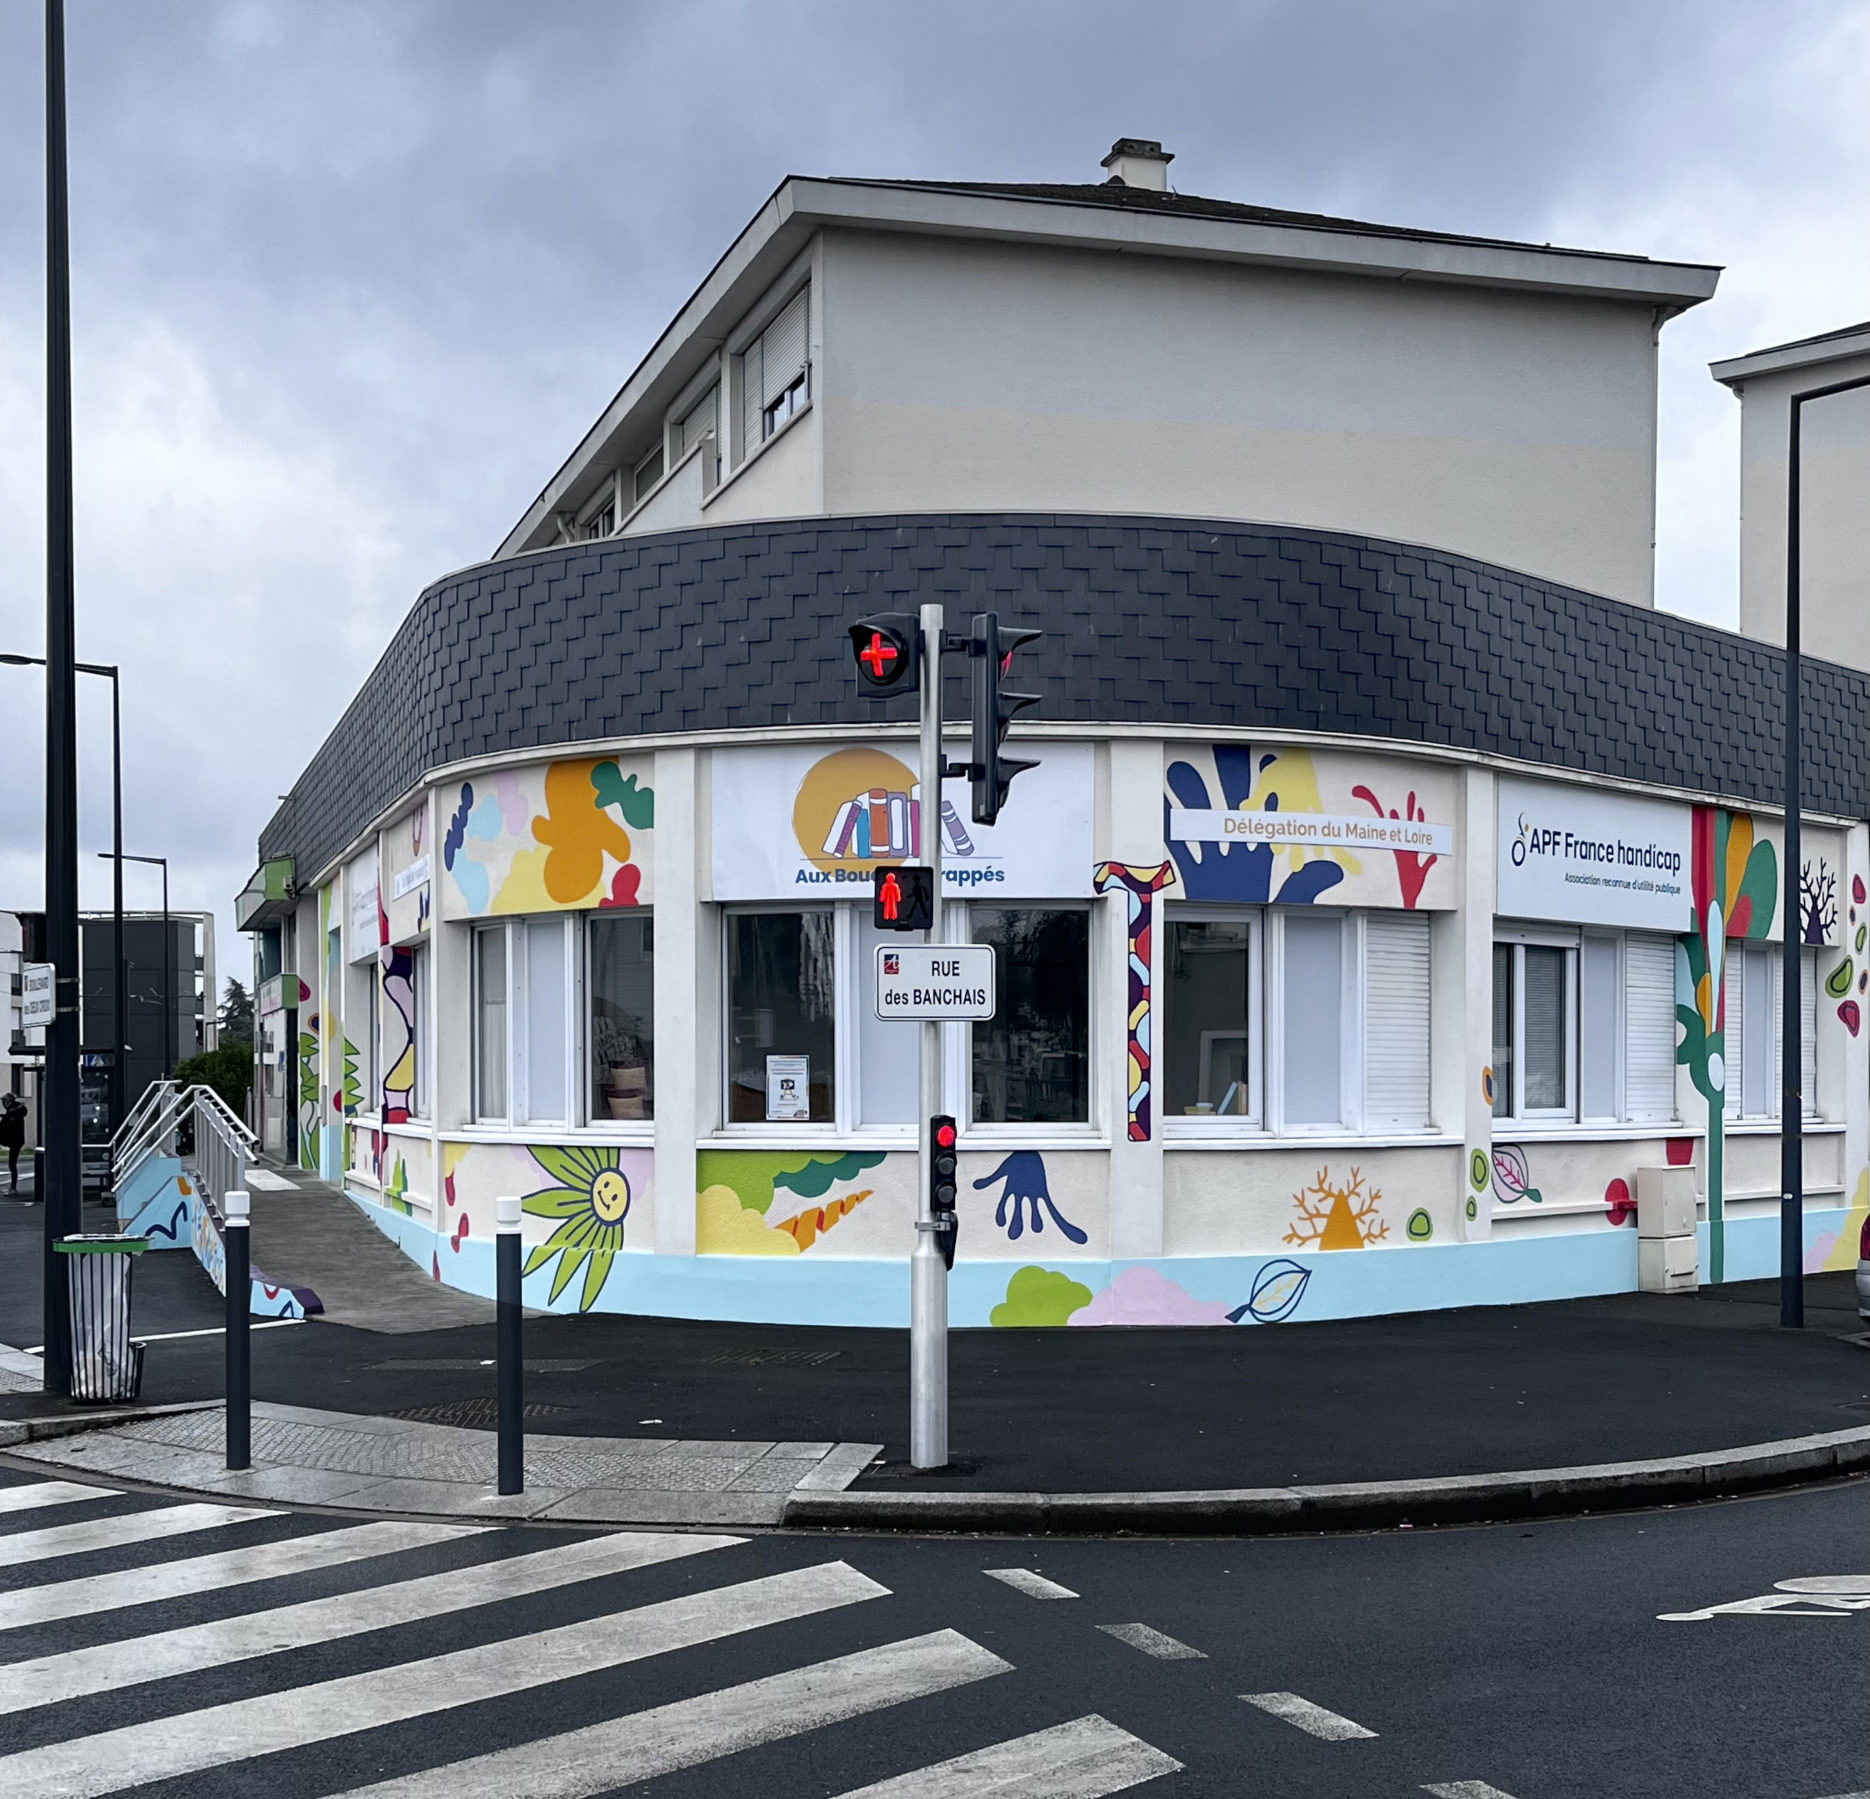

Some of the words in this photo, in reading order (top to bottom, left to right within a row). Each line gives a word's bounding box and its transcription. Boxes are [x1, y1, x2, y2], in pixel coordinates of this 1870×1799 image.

[1223, 818, 1317, 839] Délégation
[1321, 822, 1341, 838] du
[1345, 823, 1386, 841] Maine
[1390, 829, 1402, 842] et
[1404, 830, 1433, 845] Loire
[1529, 828, 1561, 856] APF
[1564, 833, 1614, 863] France
[1617, 839, 1681, 877] handicap
[795, 869, 831, 883] Aux
[1564, 872, 1601, 886] Association
[931, 960, 960, 976] RUE
[884, 988, 909, 1005] des
[913, 988, 986, 1005] BANCHAIS
